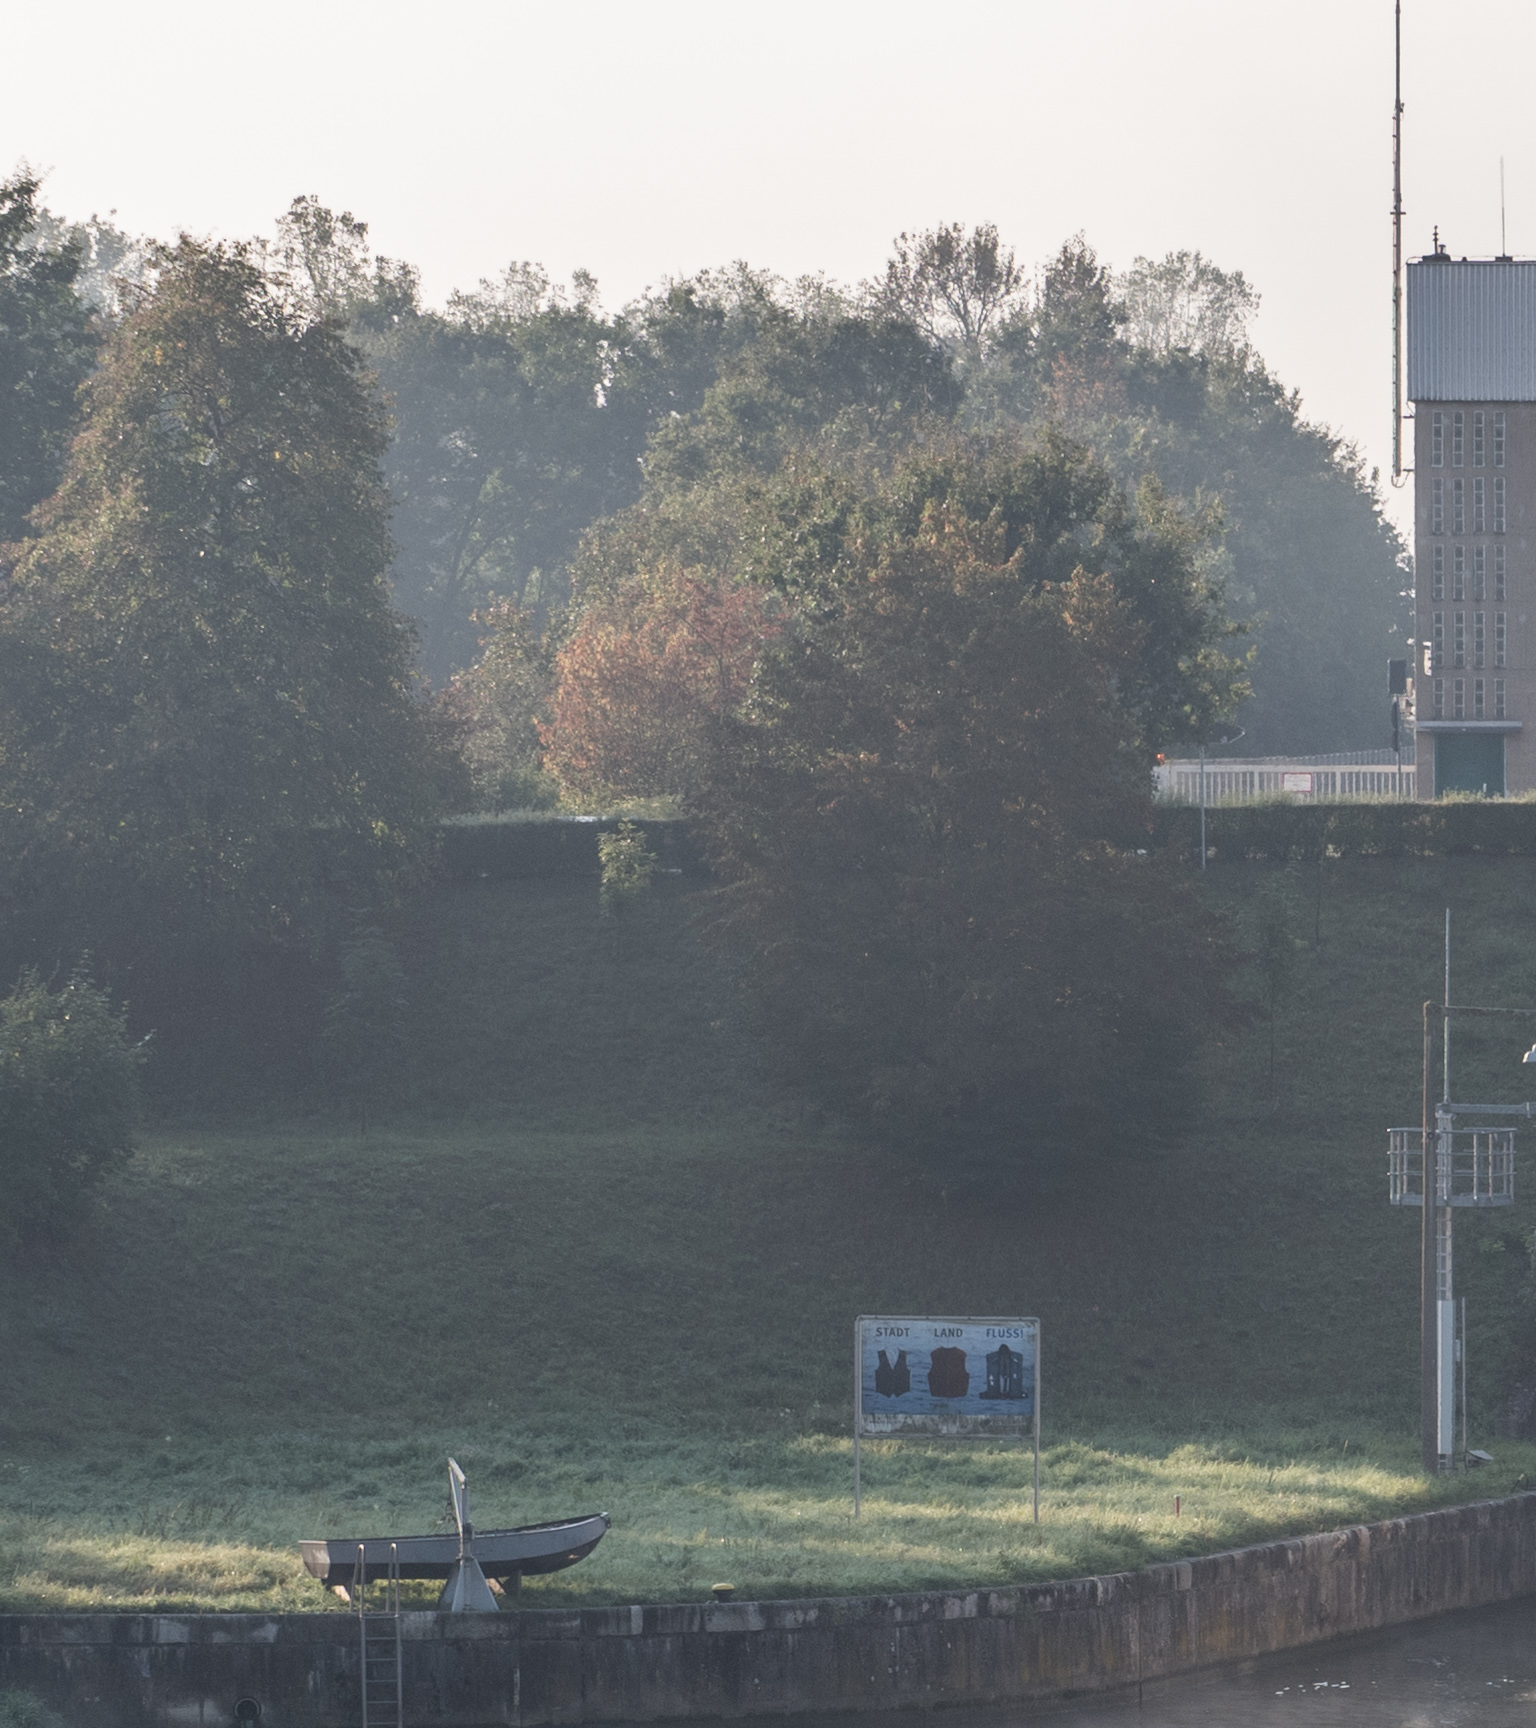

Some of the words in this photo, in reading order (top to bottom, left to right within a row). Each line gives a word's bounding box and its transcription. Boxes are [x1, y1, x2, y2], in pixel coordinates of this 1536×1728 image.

[875, 1327, 910, 1338] STADT
[934, 1327, 963, 1338] LAND
[985, 1328, 1024, 1339] FLUSS!
